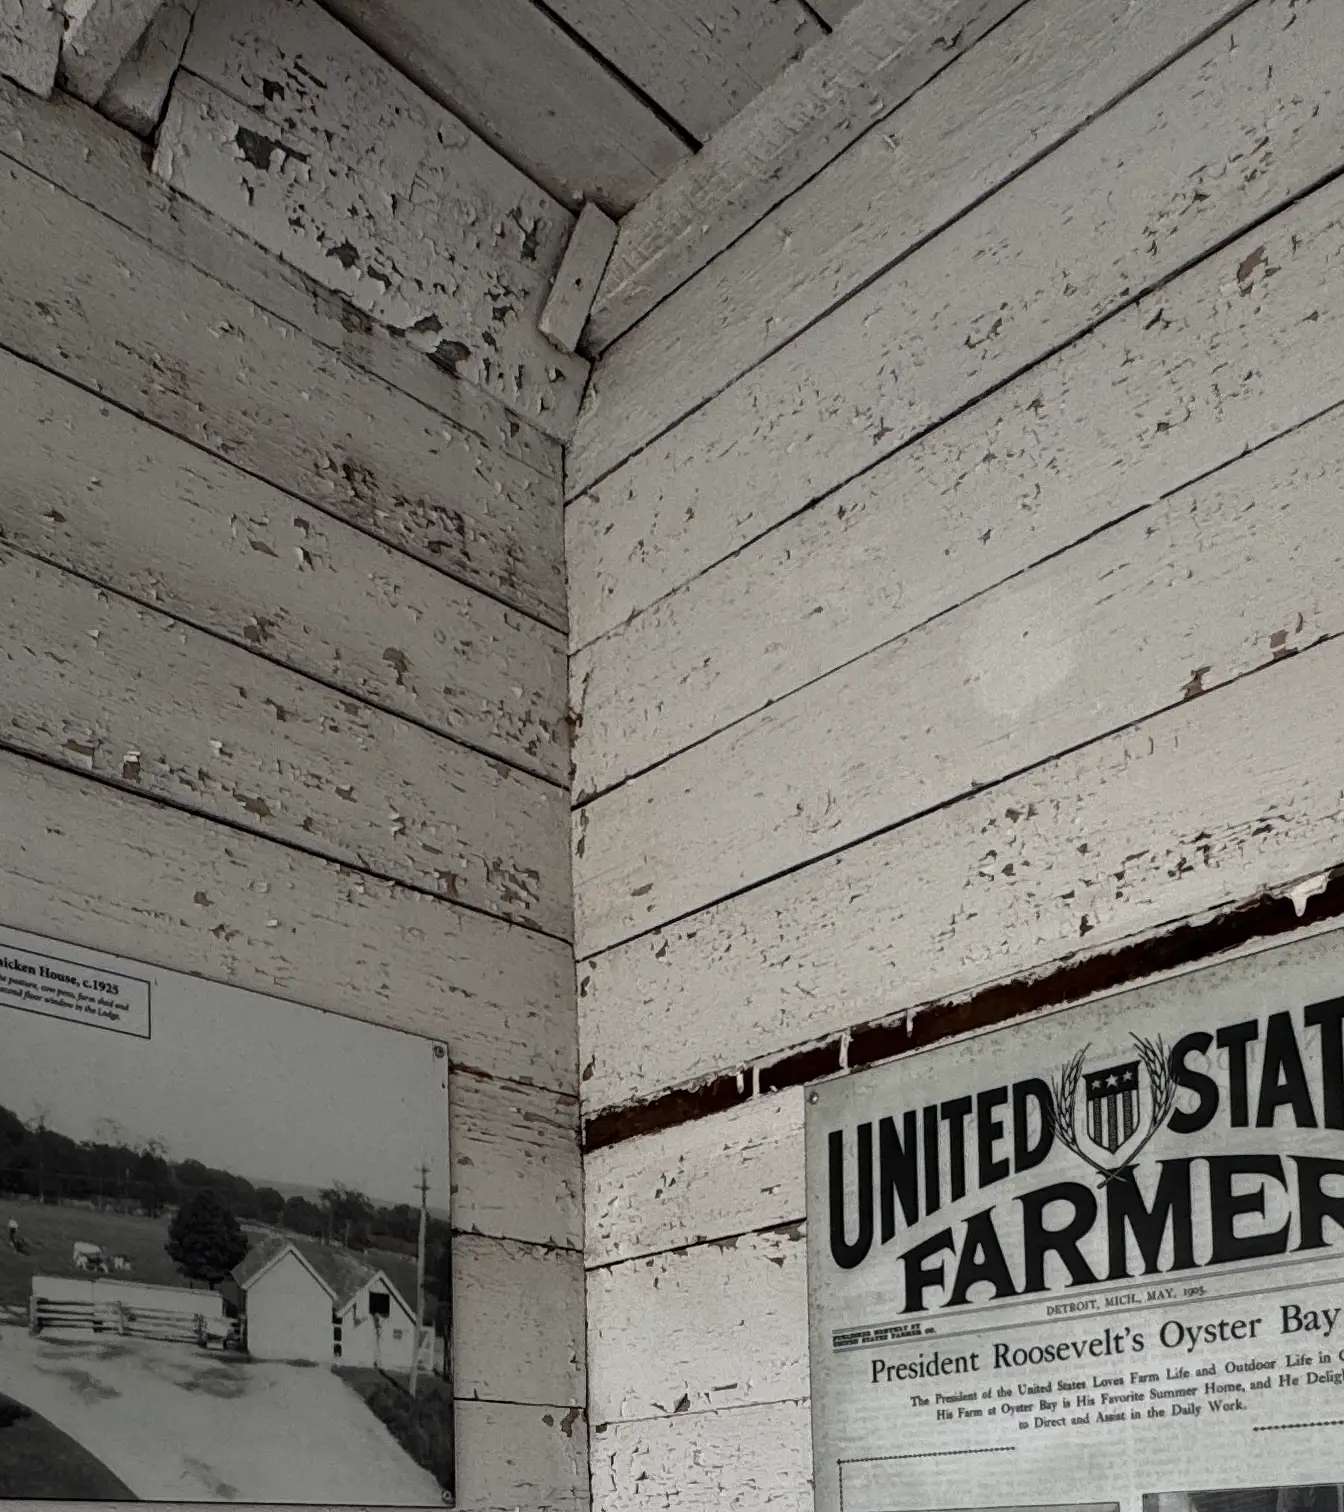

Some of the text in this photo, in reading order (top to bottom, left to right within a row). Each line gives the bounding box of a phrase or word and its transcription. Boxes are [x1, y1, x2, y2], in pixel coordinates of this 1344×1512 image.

[39, 965, 80, 988] House,
[82, 979, 119, 995] c.1925
[75, 1004, 83, 1013] in
[84, 1004, 97, 1015] the
[114, 1003, 130, 1012] and
[827, 1075, 1058, 1271] UNITED
[1046, 1299, 1101, 1316] DETROIT,
[871, 1352, 980, 1383] President
[993, 1327, 1145, 1370] Roosevelt's
[1159, 1316, 1263, 1353] Oyster
[1280, 1304, 1343, 1338] Bay
[910, 1395, 930, 1407] The
[935, 1391, 978, 1405] President
[981, 1387, 992, 1399] of
[997, 1386, 1013, 1398] the
[1017, 1381, 1053, 1396] United
[1057, 1380, 1086, 1392] States
[1092, 1376, 1125, 1389] Loves
[1130, 1372, 1160, 1385] Farm
[1166, 1366, 1190, 1380] Life
[1195, 1363, 1217, 1377] and
[1224, 1359, 1277, 1374] Outdoor
[1285, 1353, 1313, 1368] Life
[1318, 1351, 1332, 1364] in
[936, 1408, 953, 1421] His
[957, 1407, 983, 1418] Farm
[987, 1406, 997, 1416] at
[1001, 1402, 1034, 1417] Oyster
[1039, 1399, 1057, 1412] Bay
[1062, 1397, 1071, 1409] is
[1076, 1395, 1096, 1408] His
[1100, 1390, 1145, 1406] Favorite
[1149, 1386, 1198, 1401] Summer
[1204, 1381, 1246, 1396] Home,
[1249, 1376, 1272, 1390] and
[1278, 1373, 1299, 1387] He
[1018, 1398, 1247, 1430] to Direct and Assist in the Daily Work.
